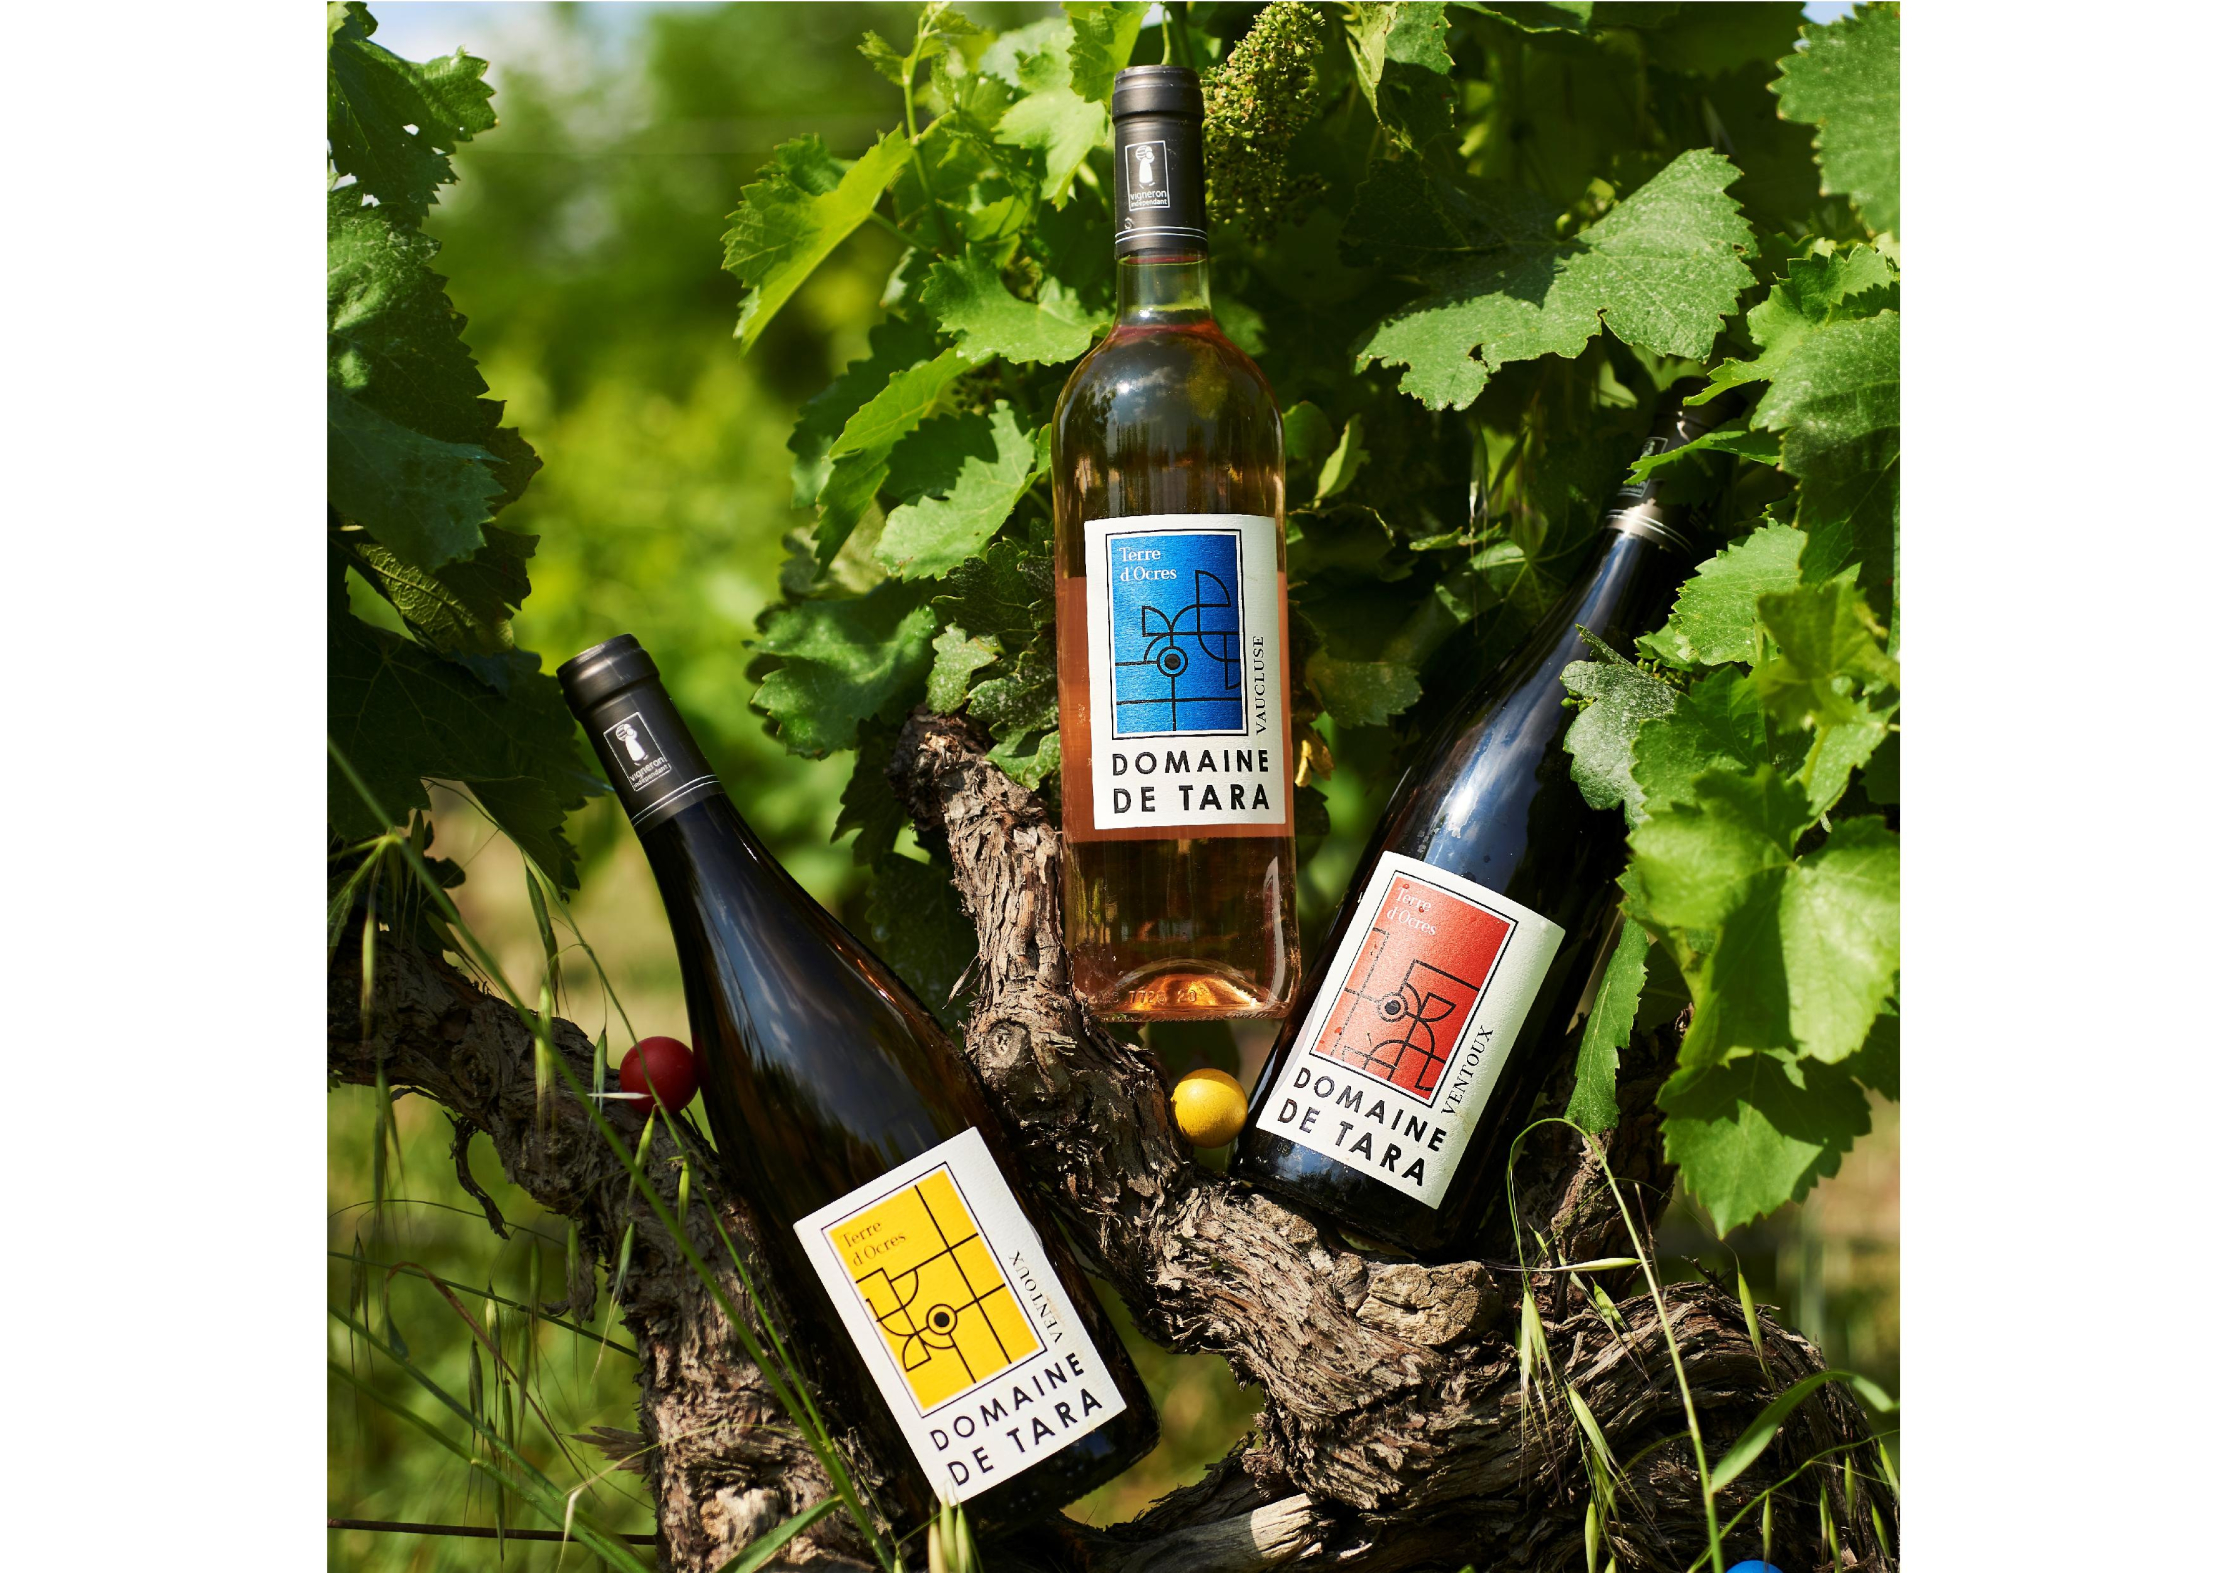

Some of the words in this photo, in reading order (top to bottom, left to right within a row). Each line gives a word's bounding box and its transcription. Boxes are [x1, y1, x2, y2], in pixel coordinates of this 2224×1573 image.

[1130, 191, 1167, 201] vigneron
[1119, 547, 1161, 562] Terre
[1120, 564, 1177, 582] d'Ocres
[1253, 635, 1266, 736] VAUCLUSE
[630, 757, 664, 780] vigneron
[1112, 750, 1269, 776] DOMAINE
[1113, 786, 1156, 814] DE
[1179, 784, 1270, 811] TARA
[1394, 886, 1432, 913] Terre
[1386, 906, 1438, 937] d'Ocres
[1441, 1024, 1494, 1116] VENTOUX
[1293, 1066, 1447, 1152] DOMAINE
[1277, 1098, 1321, 1133] DE
[1335, 1121, 1426, 1187] TARA
[842, 1220, 882, 1249] Terre
[852, 1231, 906, 1267] d'Ocres
[1008, 1250, 1064, 1345] VENTOUX
[929, 1352, 1085, 1451] DOMAINE
[947, 1446, 994, 1487] DE
[1007, 1388, 1103, 1453] TARA
